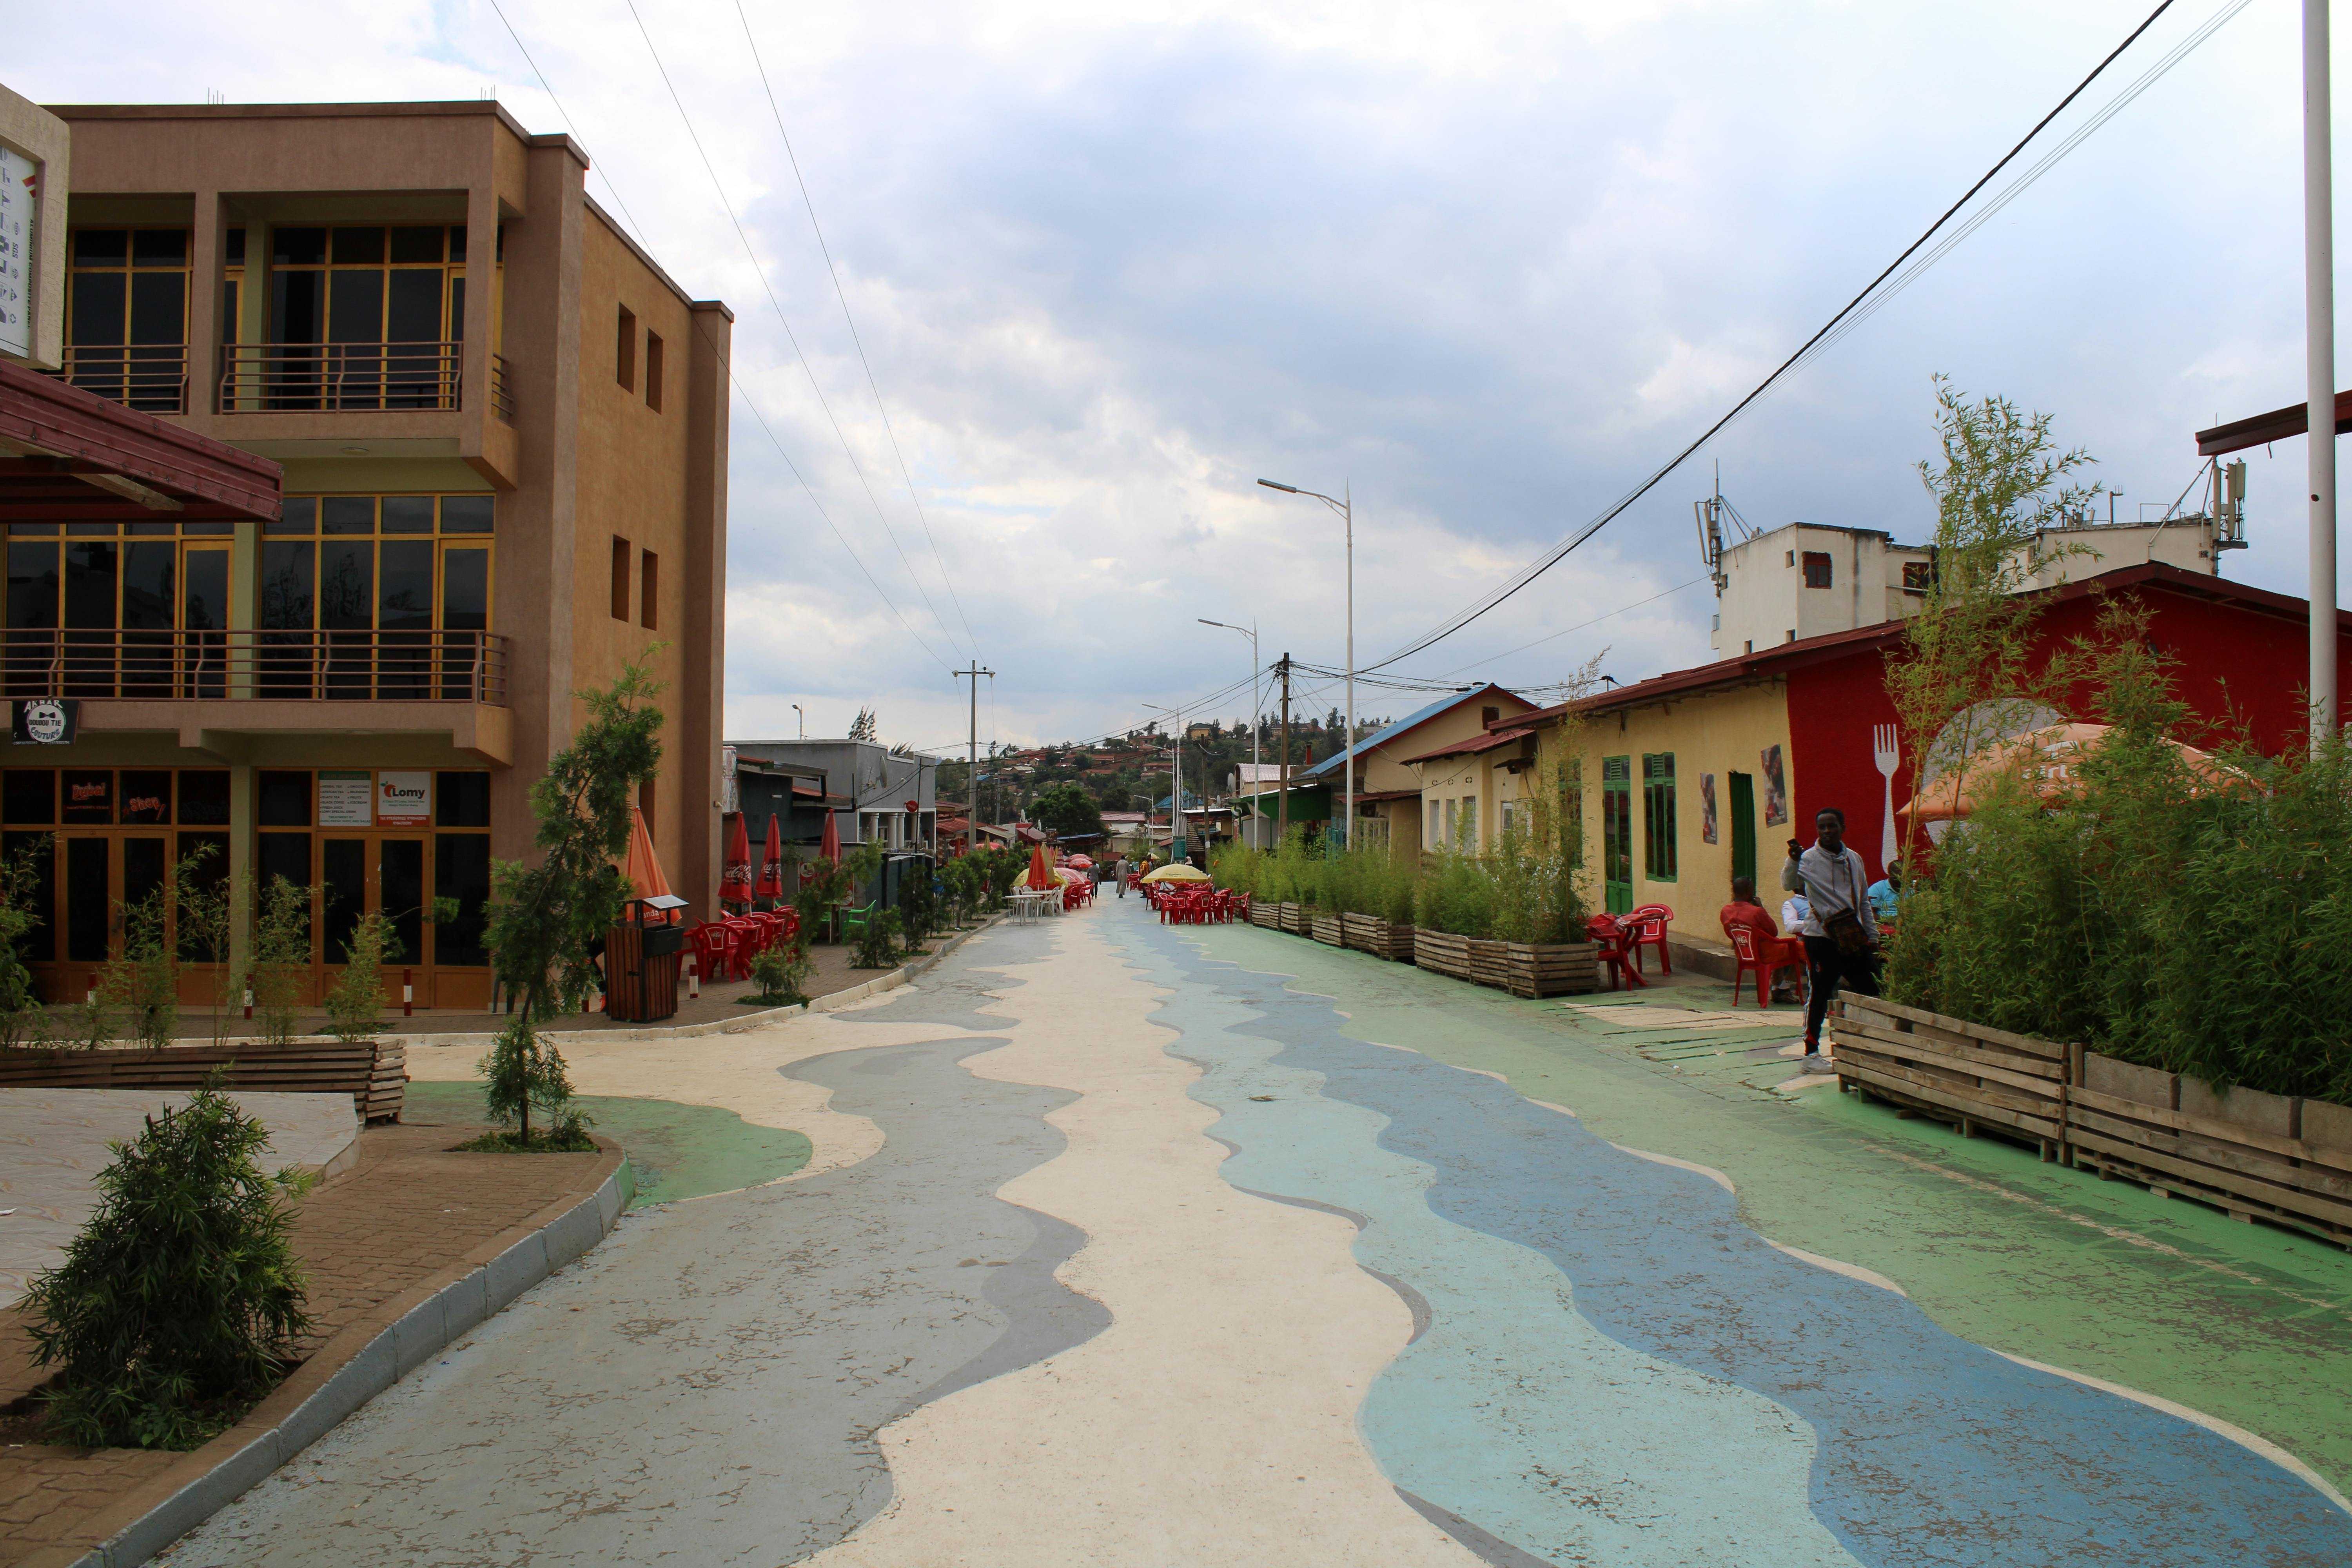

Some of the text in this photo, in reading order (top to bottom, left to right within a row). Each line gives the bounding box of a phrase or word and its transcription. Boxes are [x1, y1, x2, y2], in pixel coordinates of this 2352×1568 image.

[24, 700, 63, 713] AKBAR
[31, 727, 60, 740] COUTURE
[393, 788, 425, 799] Lomy
[643, 909, 659, 918] anda
